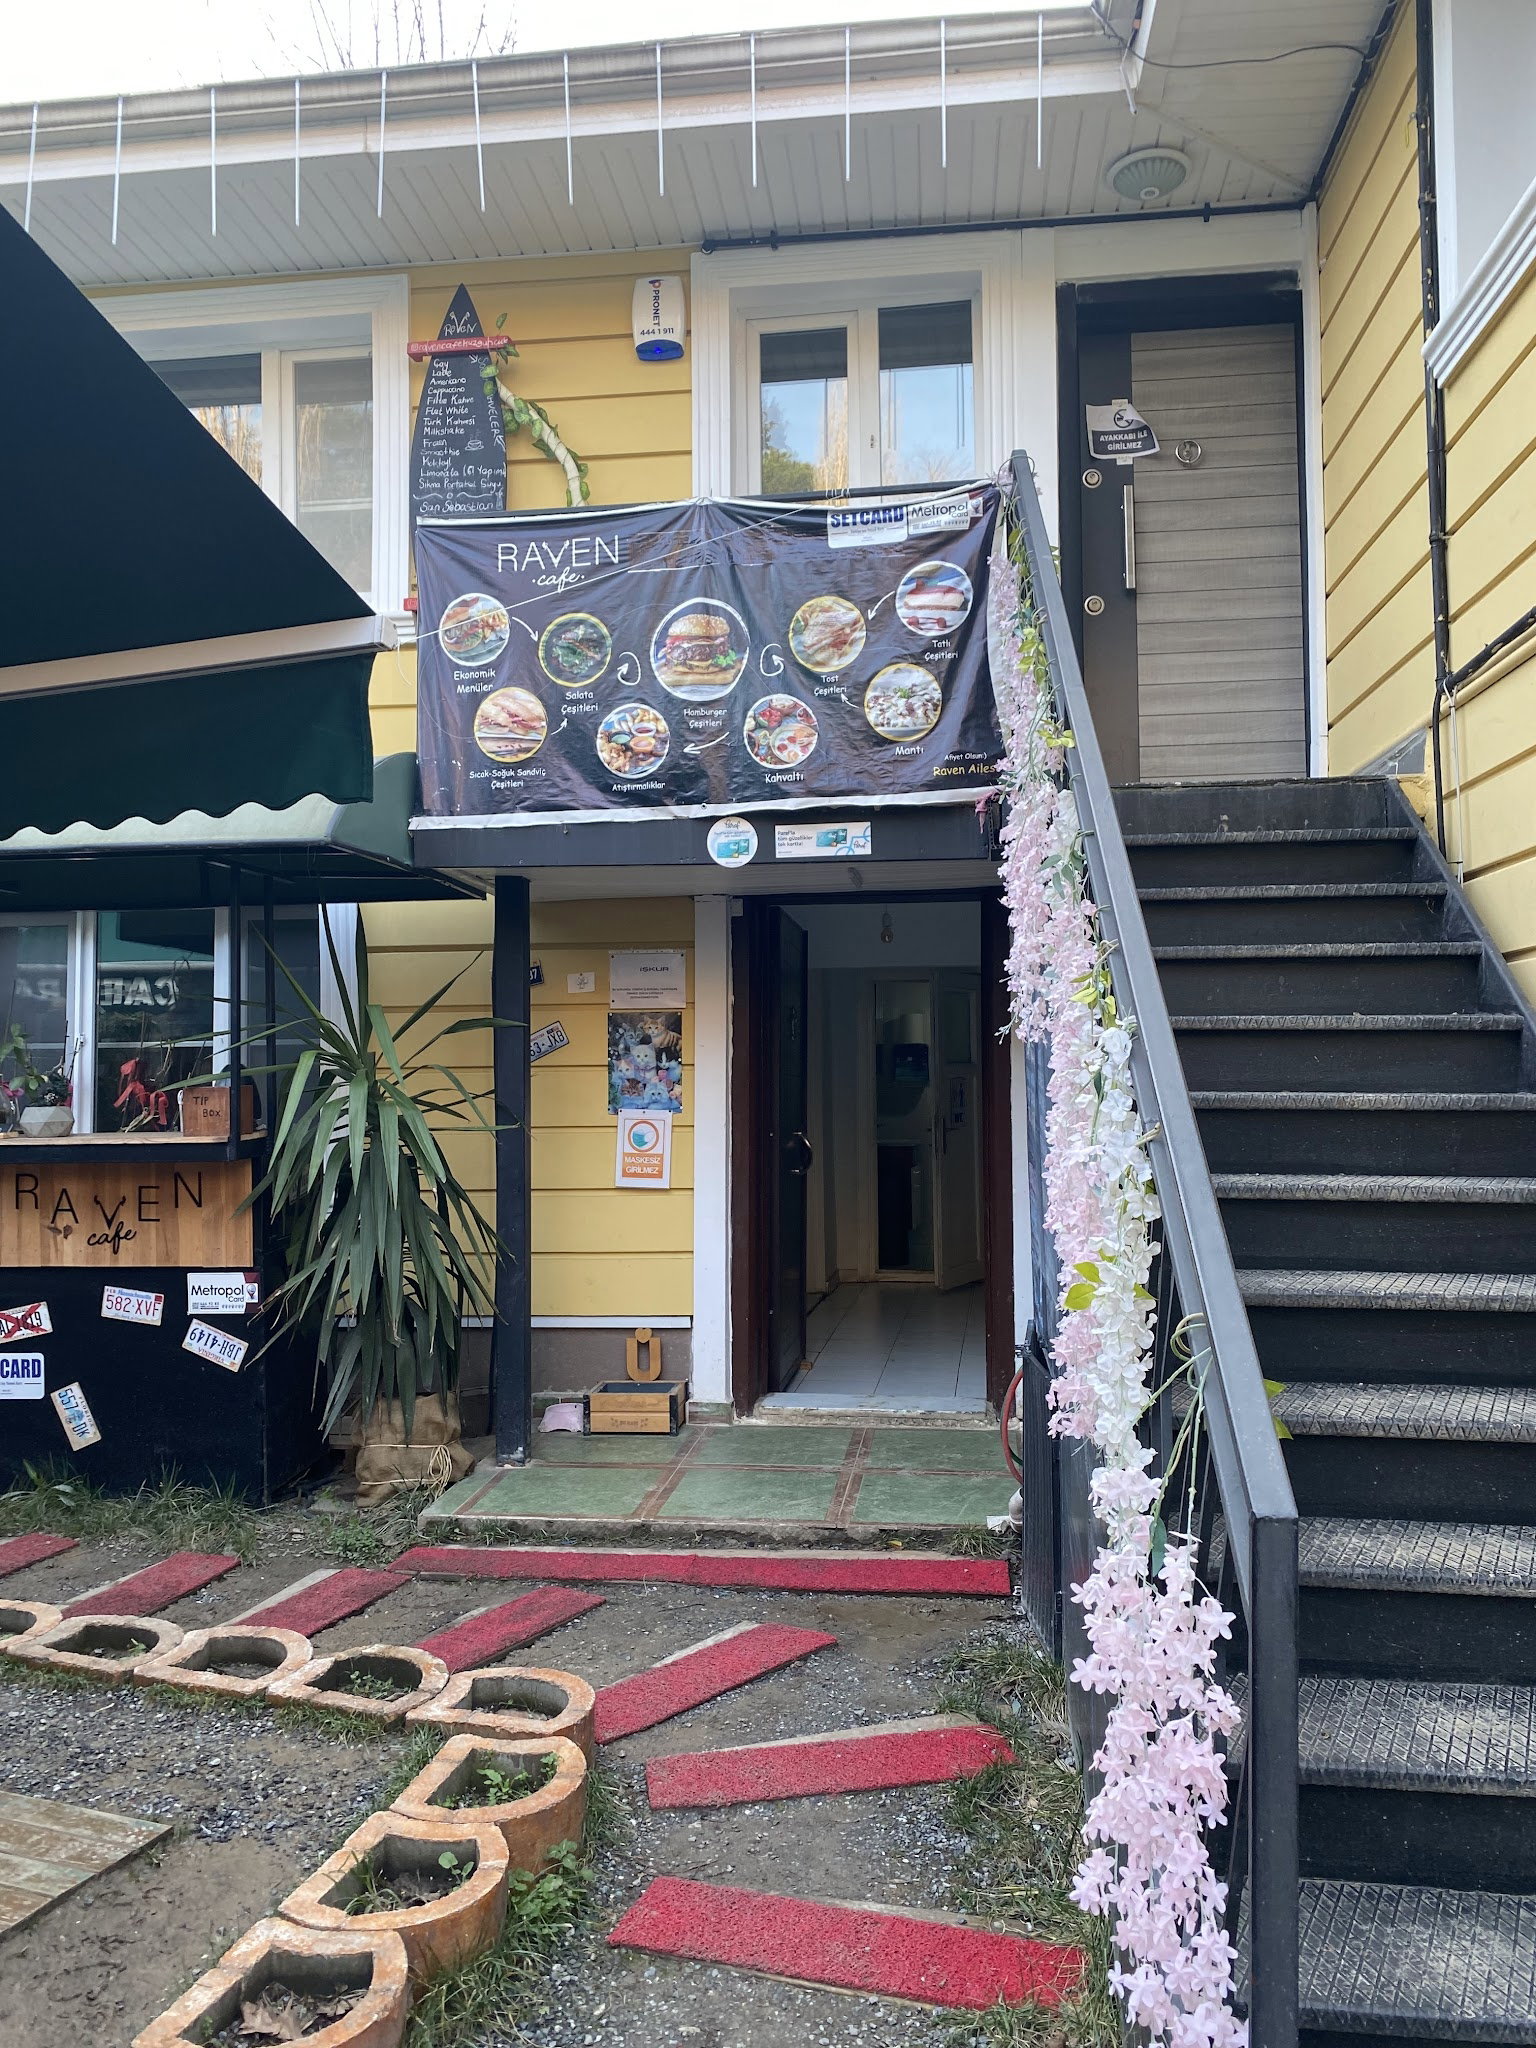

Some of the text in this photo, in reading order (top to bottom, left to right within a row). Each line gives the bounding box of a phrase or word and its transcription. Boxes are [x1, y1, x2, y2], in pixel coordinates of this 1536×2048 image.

[652, 289, 660, 327] PRONET
[429, 377, 467, 386] Americano
[445, 405, 469, 415] White
[423, 427, 465, 436] Milkshake
[1099, 429, 1148, 442] AYAKKABI İLE
[1107, 441, 1142, 451] GİRİLMEZ
[420, 500, 494, 512] San Sebastian
[911, 501, 969, 519] Metropol
[830, 506, 904, 528] SETCARD
[497, 535, 619, 573] RAVEN
[532, 567, 584, 593] cafe
[924, 651, 959, 661] Çeşitleri
[453, 669, 496, 681] Ekonomik
[820, 675, 839, 684] Tost
[456, 682, 494, 694] Menüler
[813, 684, 847, 696] Çeşitleri
[565, 690, 594, 701] Salata
[561, 702, 599, 714] Çeşitleri
[683, 708, 728, 718] Hamburger
[689, 719, 722, 729] Çeşitleri
[895, 745, 924, 755] Mantı
[469, 767, 546, 779] Sıcak-Soğuk Sandviç
[933, 763, 996, 777] Raven Ailes
[490, 779, 524, 789] Çeşitleri
[765, 772, 804, 784] Kahvaltı
[612, 781, 666, 792] Atıştırmalıklar
[193, 1096, 209, 1106] TIP
[624, 1156, 661, 1165] MASKESİZ
[625, 1165, 659, 1174] GİRİLMEZ
[15, 1171, 203, 1229] RAVEN
[87, 1221, 137, 1255] cafe
[191, 1285, 244, 1299] Metropol
